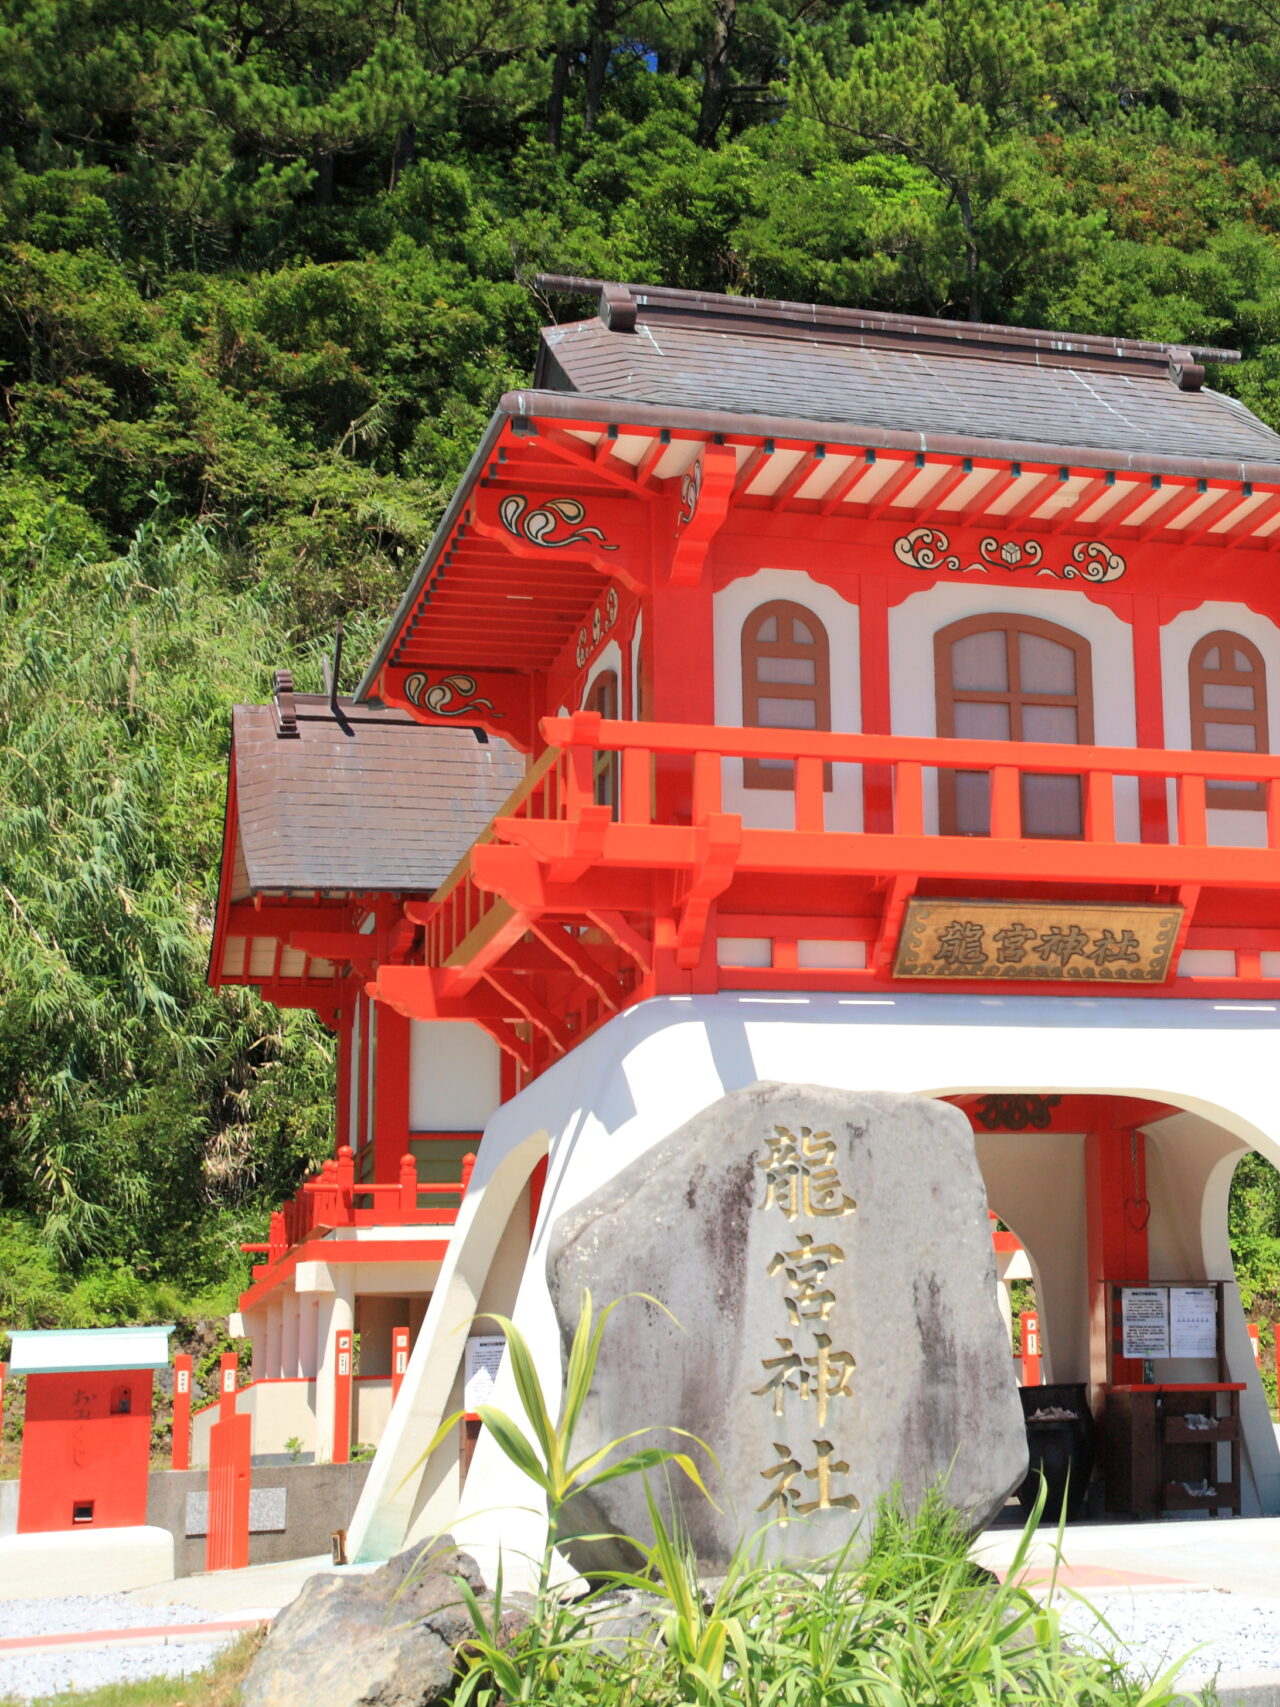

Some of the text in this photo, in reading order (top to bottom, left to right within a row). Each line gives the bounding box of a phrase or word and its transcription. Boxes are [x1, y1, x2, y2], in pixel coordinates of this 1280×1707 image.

[933, 920, 1141, 966] 龍宮神社
[751, 1123, 860, 1528] 龍宮神社
[72, 1388, 97, 1469] おみくじ
